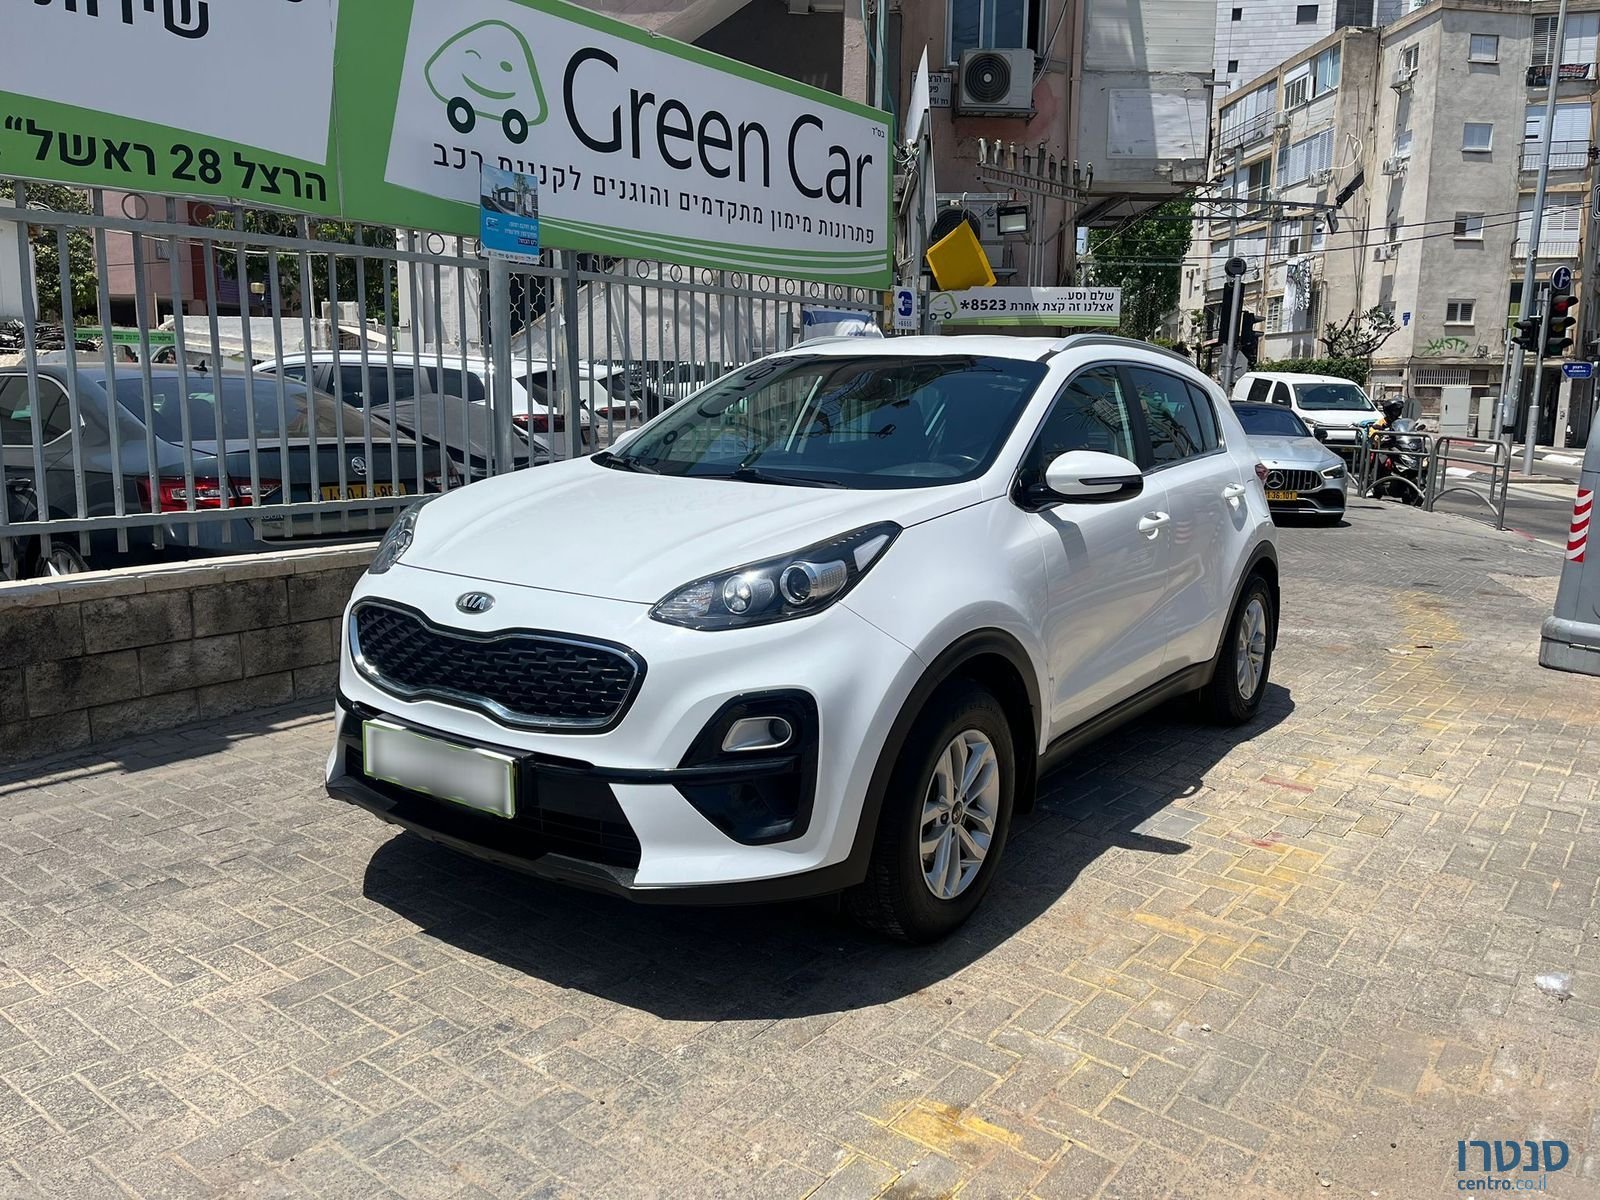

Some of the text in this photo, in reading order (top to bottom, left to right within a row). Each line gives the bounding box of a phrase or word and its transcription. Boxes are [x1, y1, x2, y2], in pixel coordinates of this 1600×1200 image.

[563, 47, 873, 208] Green Car
[1, 115, 327, 202] הרצל 28 ראשל"
[433, 143, 484, 173] רכב
[593, 175, 669, 207] והוגנים
[679, 191, 763, 224] מתקדמים
[770, 209, 812, 233] מימון
[818, 219, 874, 244] פתרונות
[1009, 302, 1040, 311] אחרת
[1042, 302, 1065, 313] קצת
[1068, 302, 1081, 312] זה
[1083, 302, 1114, 312] אצלנו
[1090, 291, 1115, 301] שלם
